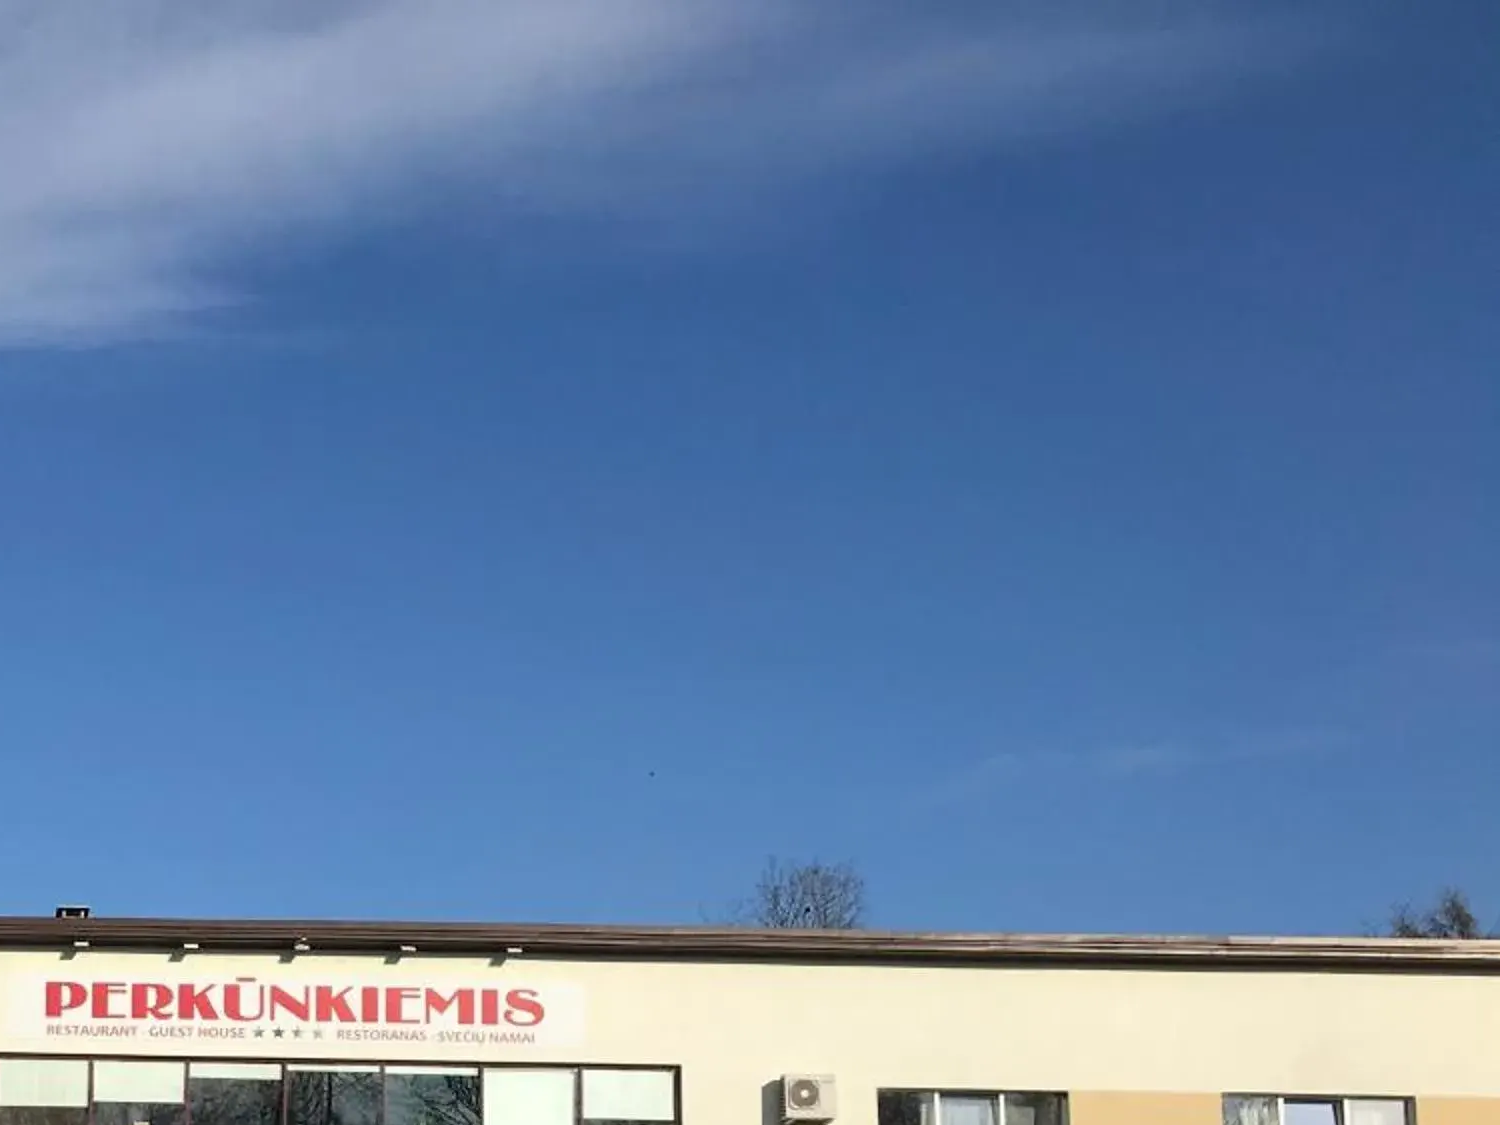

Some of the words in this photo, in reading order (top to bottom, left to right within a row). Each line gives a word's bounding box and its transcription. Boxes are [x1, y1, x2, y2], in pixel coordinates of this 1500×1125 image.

[45, 977, 545, 1027] PERKŪNKIEMIS
[46, 1024, 138, 1037] RESTAURANT
[149, 1025, 194, 1038] GUEST
[197, 1026, 246, 1039] HOUSE
[336, 1030, 427, 1042] RESTORANAS
[489, 1032, 536, 1044] NAMAI
